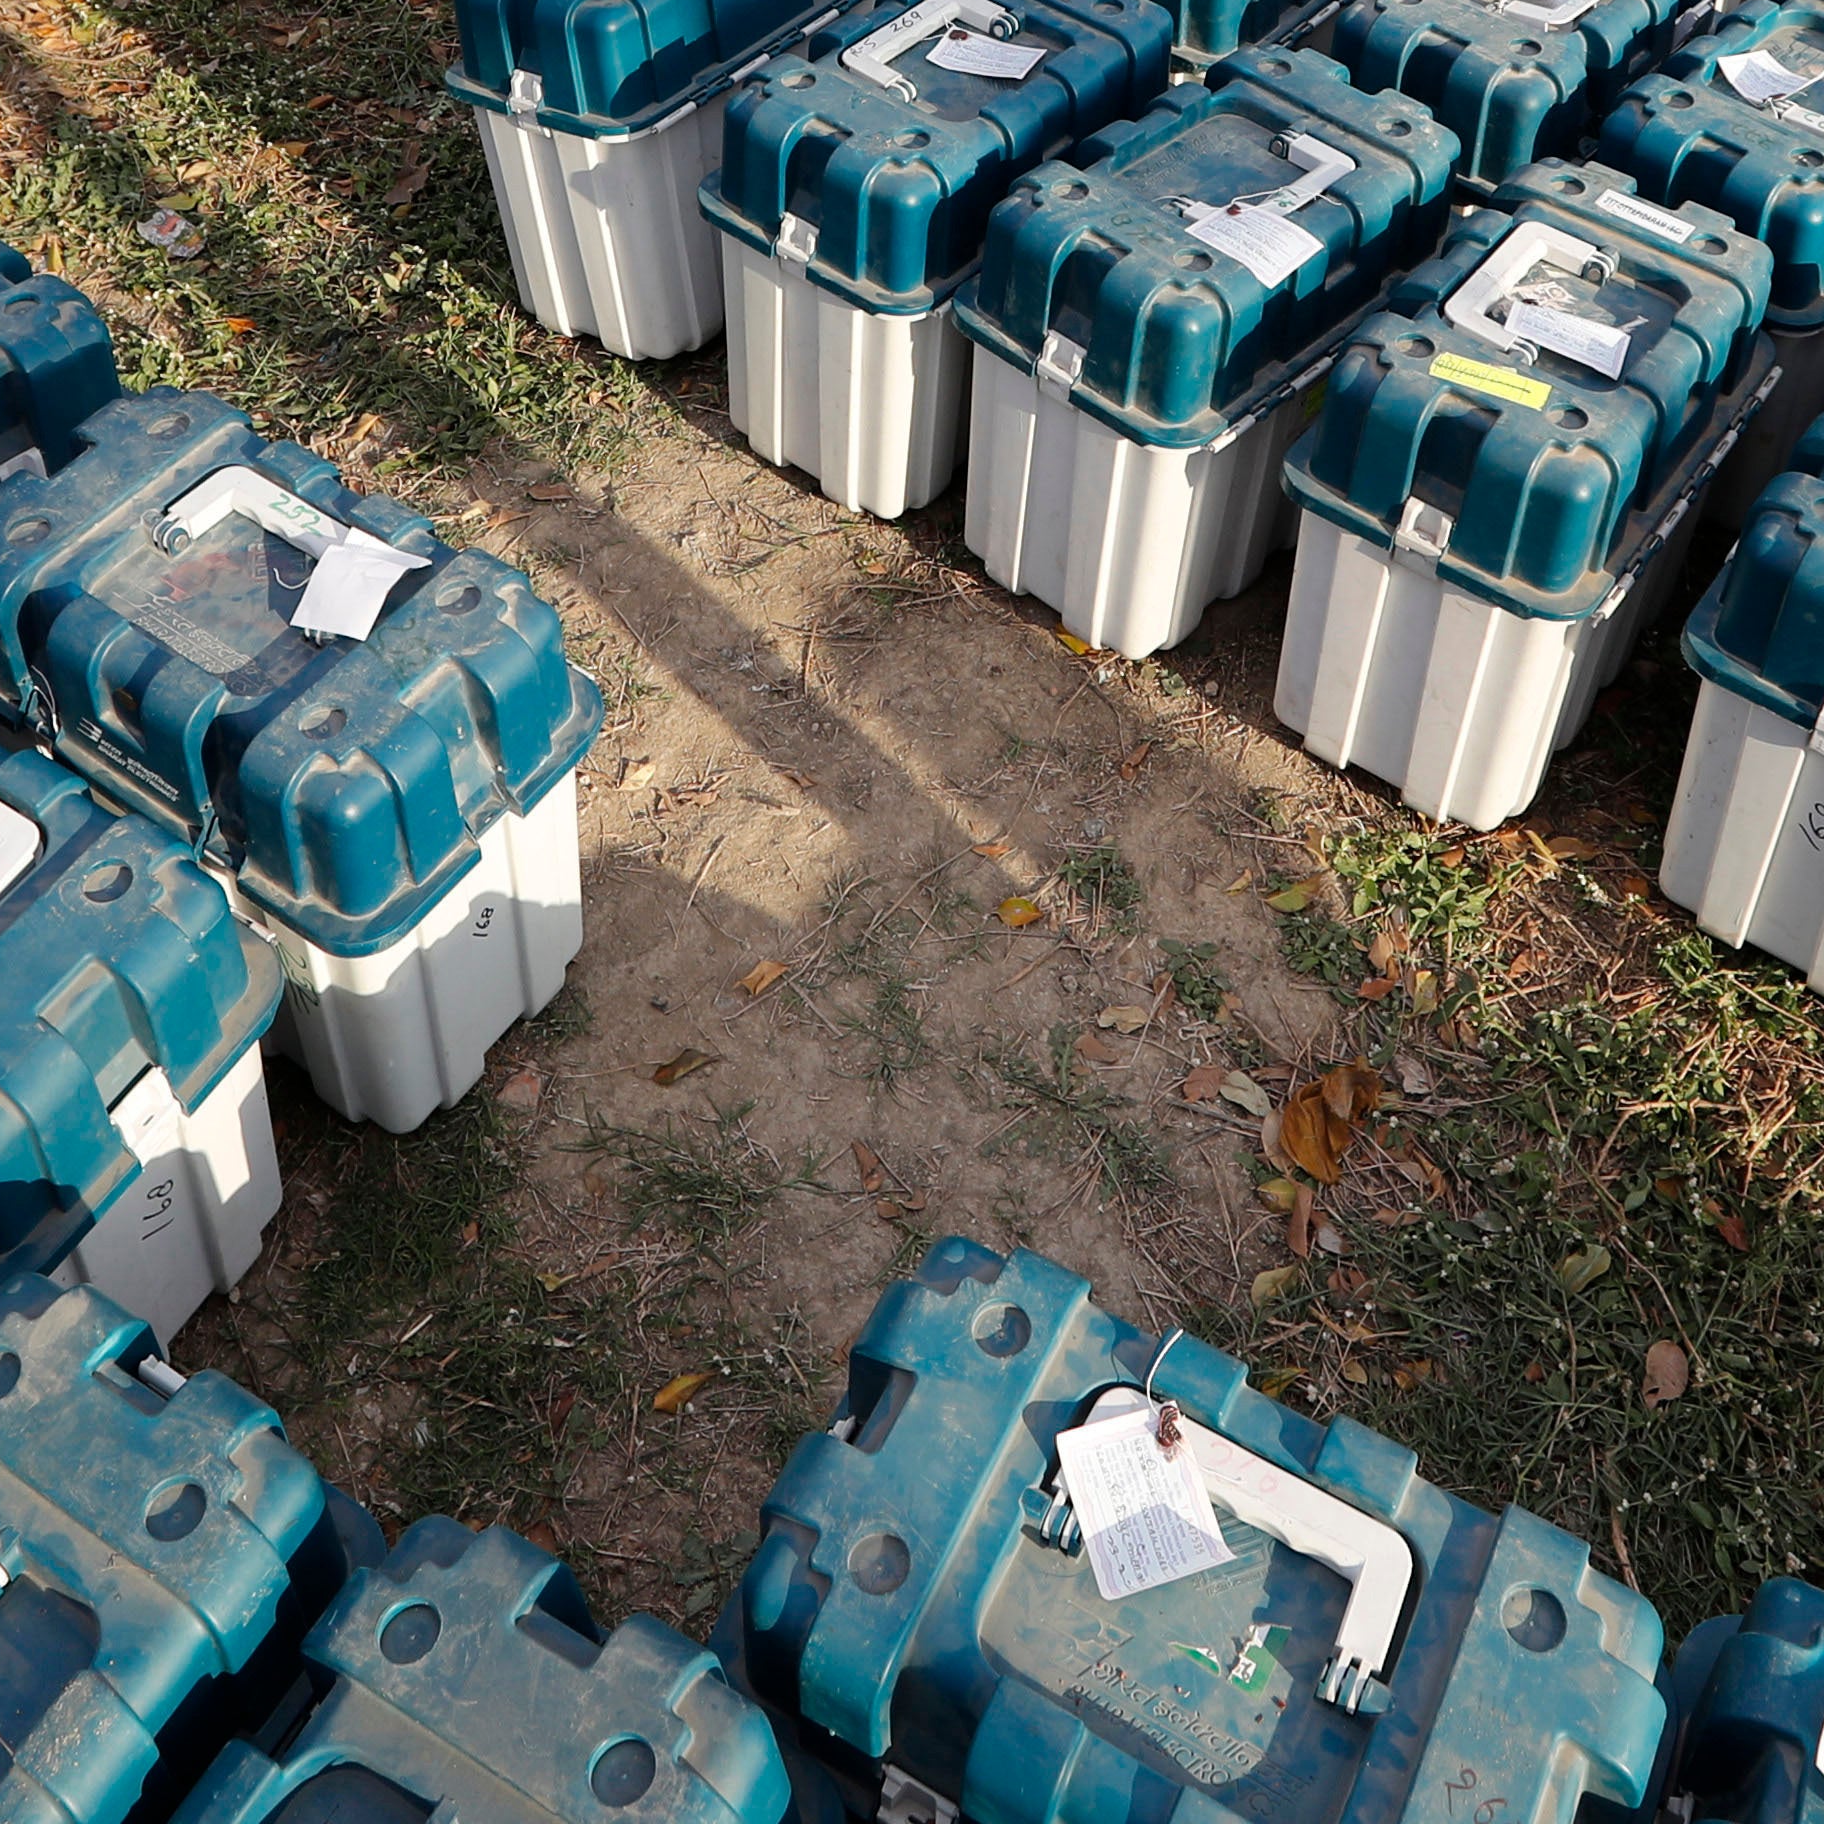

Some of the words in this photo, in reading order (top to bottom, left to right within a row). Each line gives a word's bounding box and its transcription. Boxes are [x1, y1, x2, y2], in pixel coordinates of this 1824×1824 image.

[889, 10, 923, 33] 269
[472, 907, 495, 938] 168
[142, 1178, 175, 1241] 168
